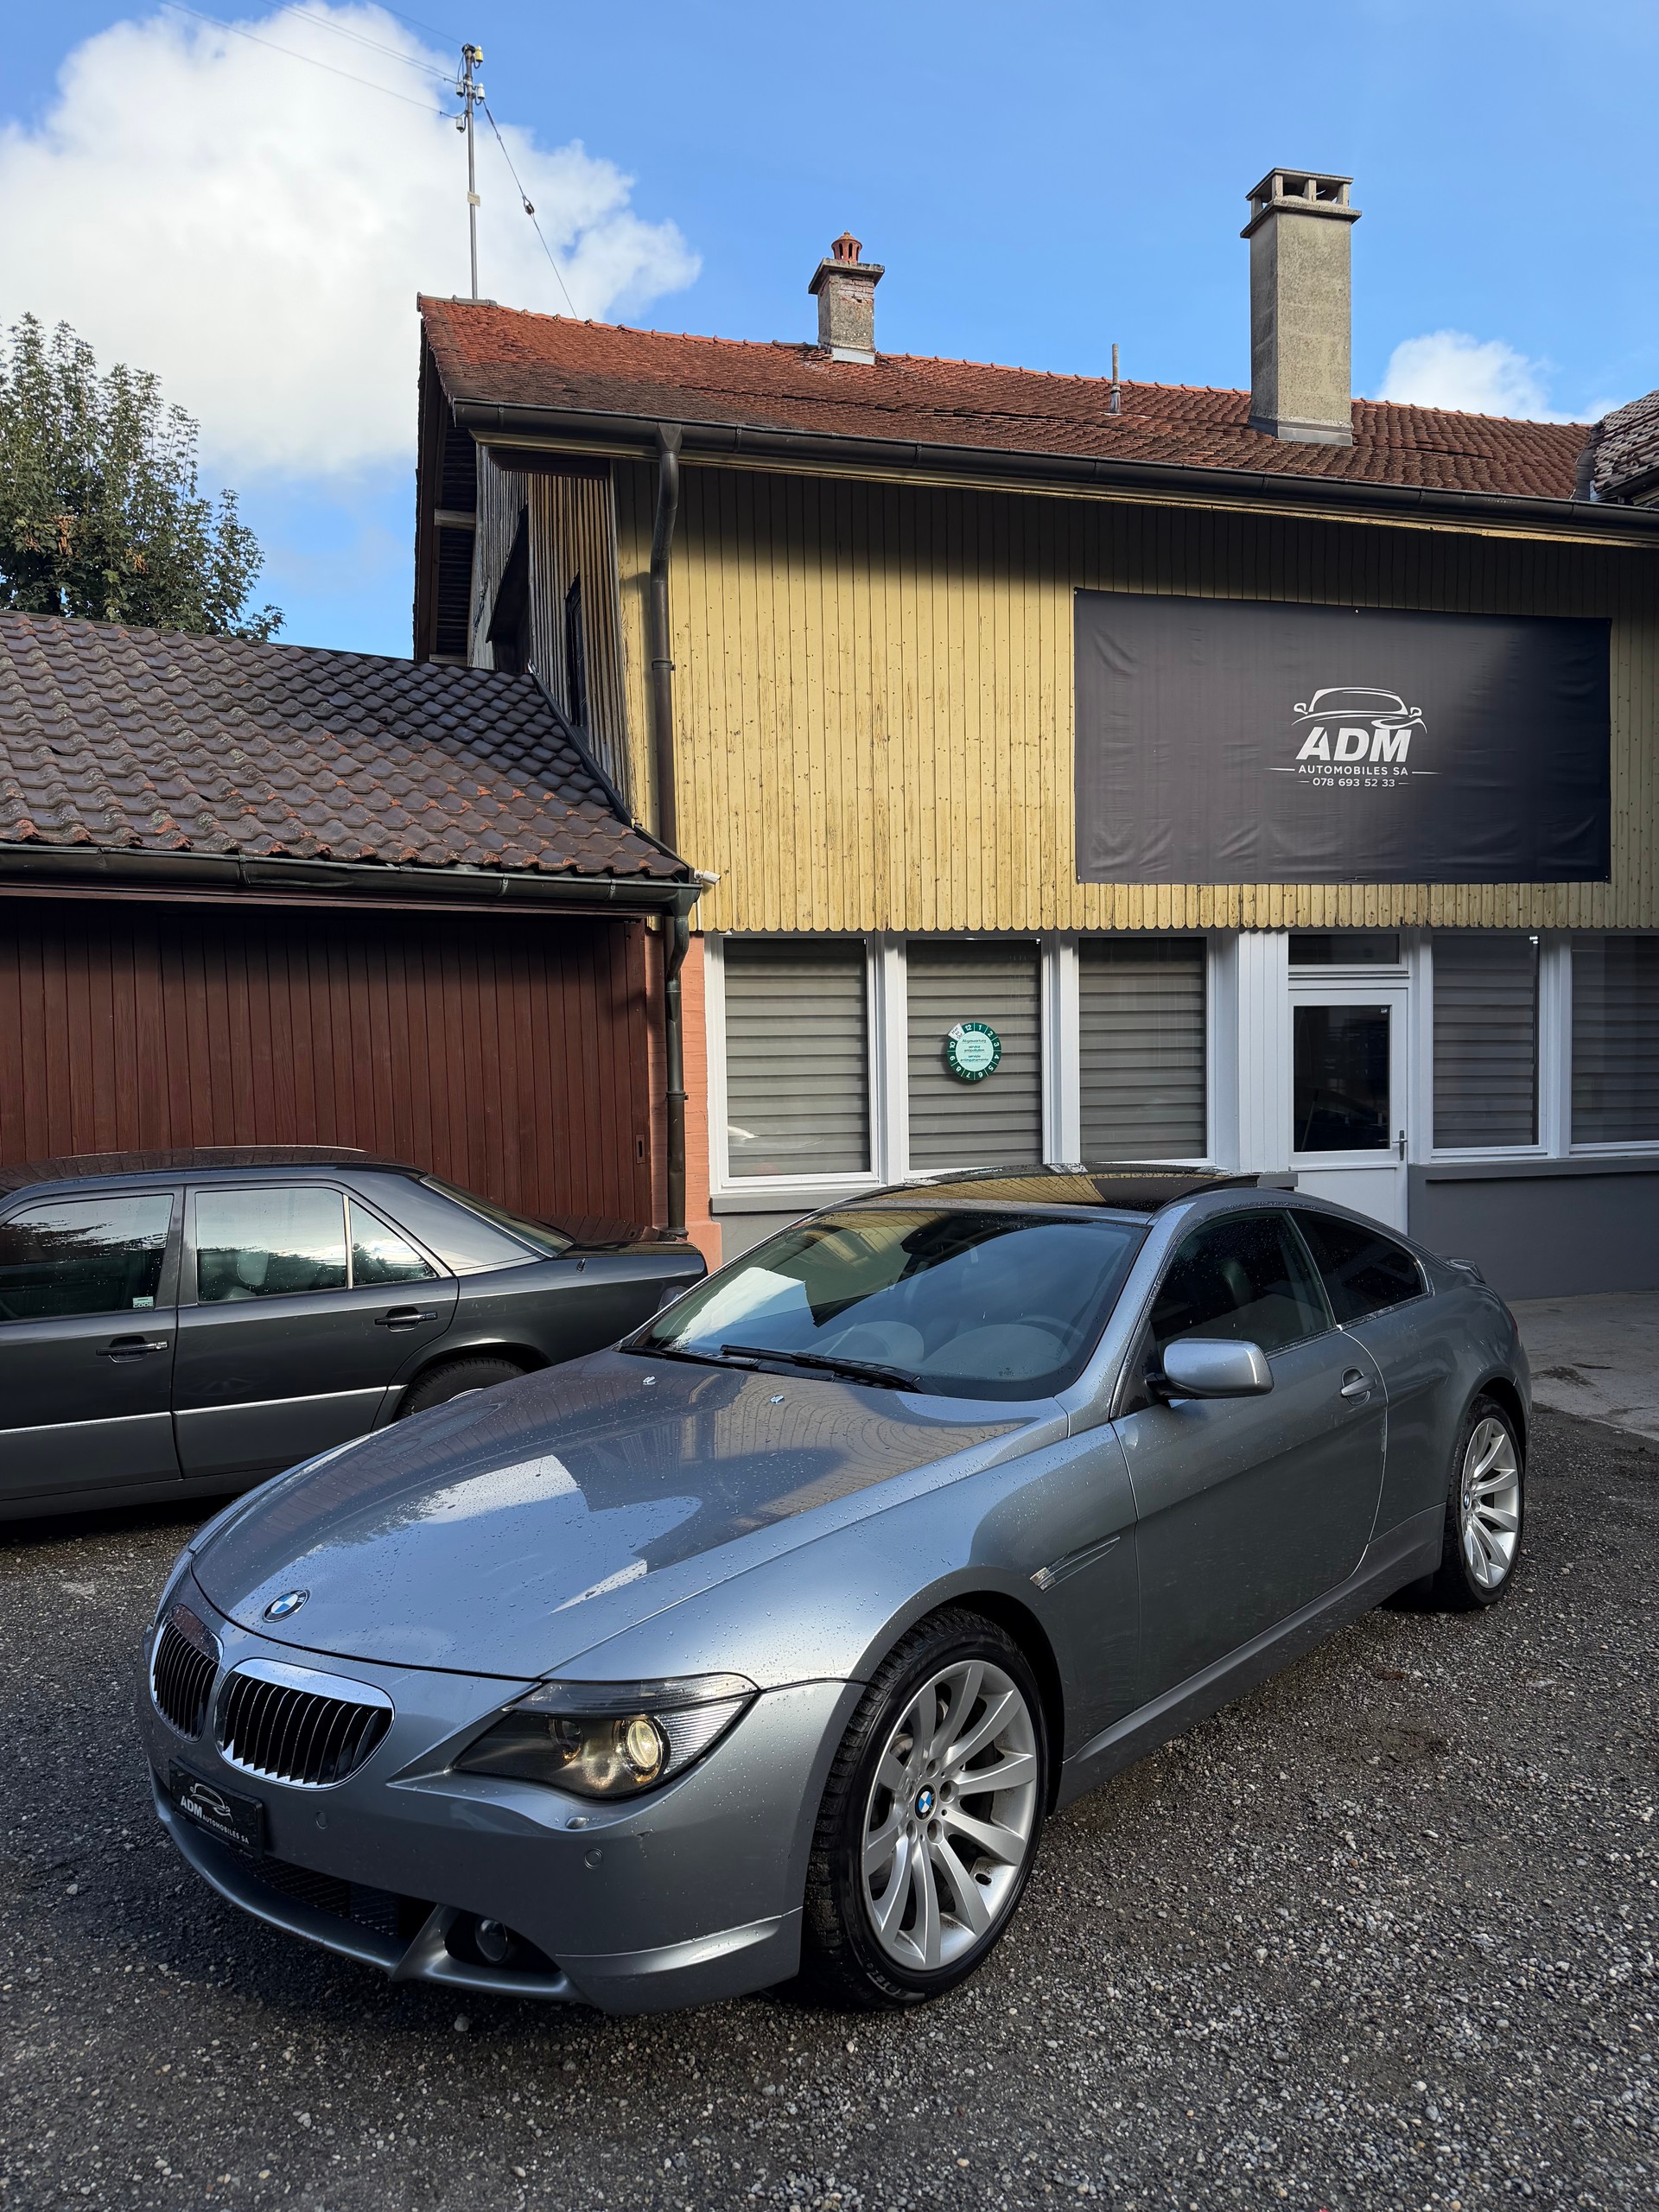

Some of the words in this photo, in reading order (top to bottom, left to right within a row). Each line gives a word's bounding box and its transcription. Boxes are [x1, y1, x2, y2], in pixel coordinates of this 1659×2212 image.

[1295, 726, 1412, 762] ADM
[1298, 764, 1388, 775] AUTOMOBILES
[1393, 766, 1408, 776] SA
[1313, 778, 1334, 786] 078
[1338, 778, 1360, 787] 693
[1364, 779, 1378, 787] 52
[180, 1796, 203, 1819] ADM
[203, 1815, 239, 1839] AUTOMOBILES
[241, 1835, 249, 1844] SA
